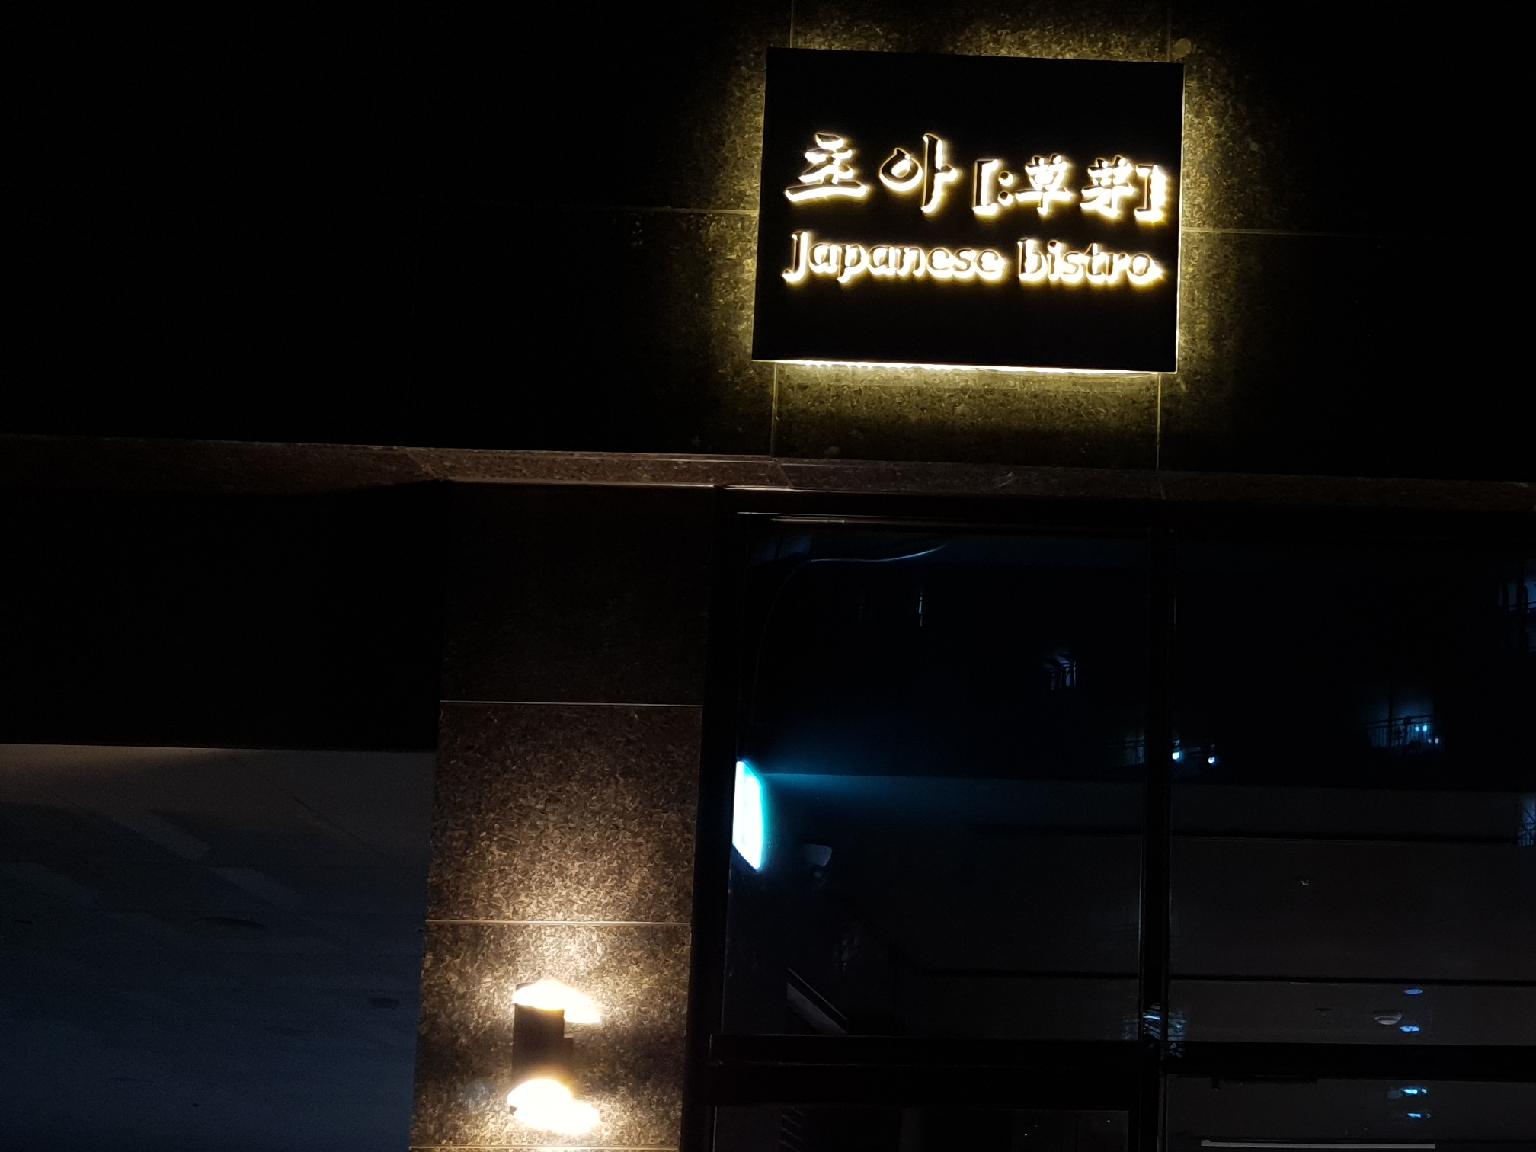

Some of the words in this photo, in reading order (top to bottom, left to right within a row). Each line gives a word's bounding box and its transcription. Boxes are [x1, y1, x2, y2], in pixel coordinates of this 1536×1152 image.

[784, 132, 961, 215] 초아
[783, 230, 1009, 284] Japanese
[1017, 237, 1166, 286] bistro
